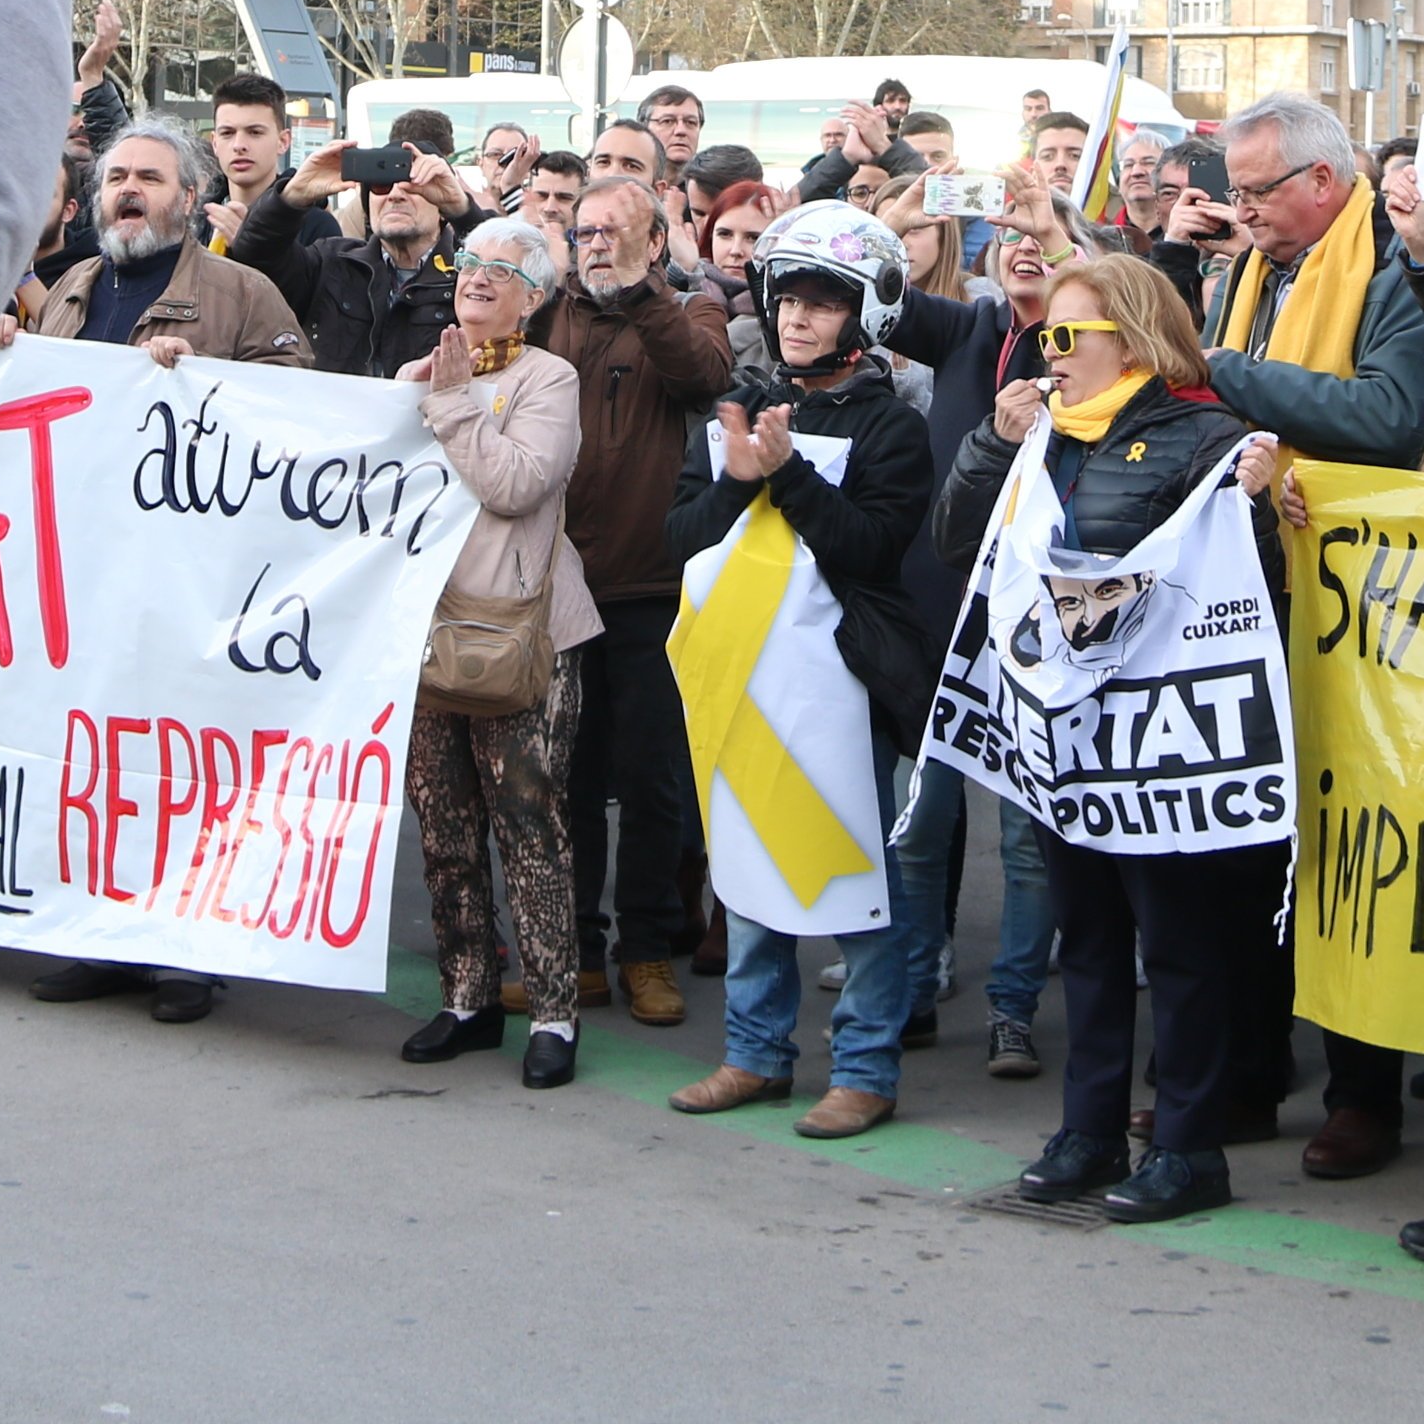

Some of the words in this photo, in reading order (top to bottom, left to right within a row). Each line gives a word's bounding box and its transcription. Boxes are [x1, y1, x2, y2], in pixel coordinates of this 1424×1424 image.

[484, 53, 515, 72] pans
[132, 380, 450, 556] aturem
[227, 562, 322, 681] la
[1182, 614, 1261, 641] CUIXART
[1203, 597, 1260, 621] JORDI
[57, 701, 395, 948] REPRESSIÓ
[932, 694, 1044, 816] RESOS
[1049, 774, 1286, 838] POLÍTICS
